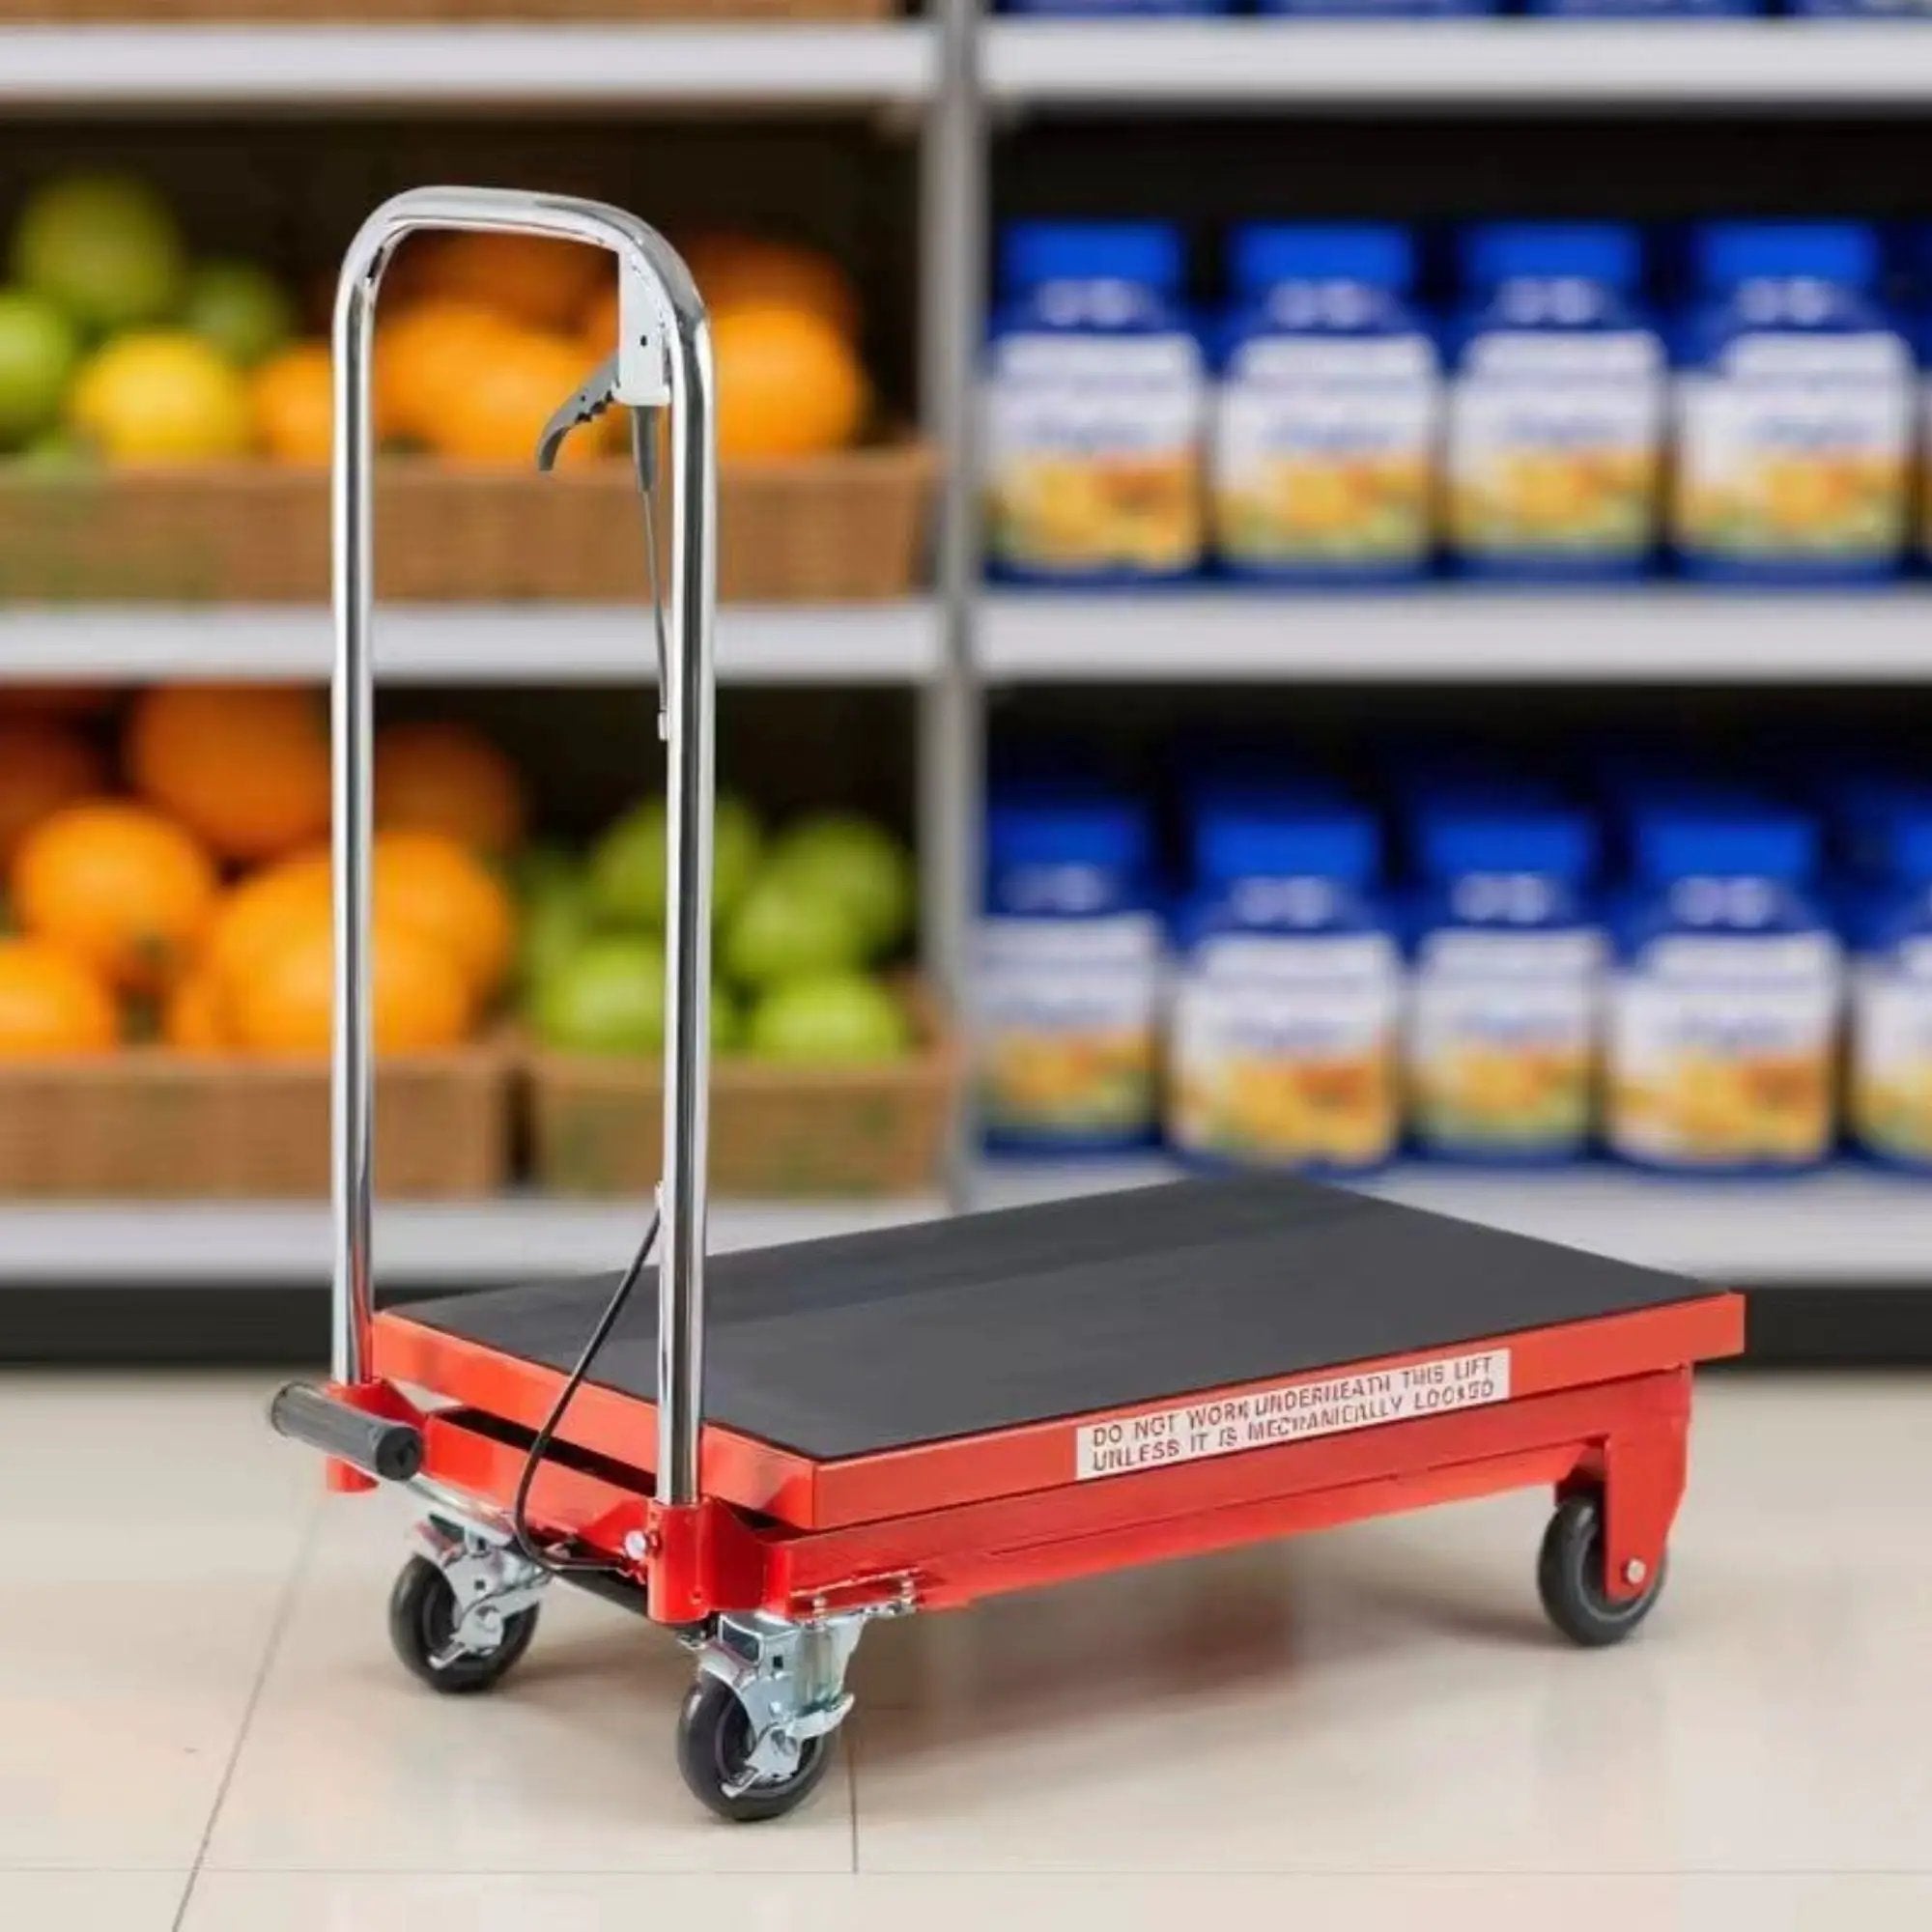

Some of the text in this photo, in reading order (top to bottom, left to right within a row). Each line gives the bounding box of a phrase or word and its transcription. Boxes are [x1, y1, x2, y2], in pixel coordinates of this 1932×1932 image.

[1093, 1424, 1122, 1447] DO
[1454, 1356, 1493, 1380] LIFT
[1093, 1438, 1179, 1472] UNLESS
[1190, 1433, 1208, 1452] IT
[1218, 1427, 1238, 1447] IS
